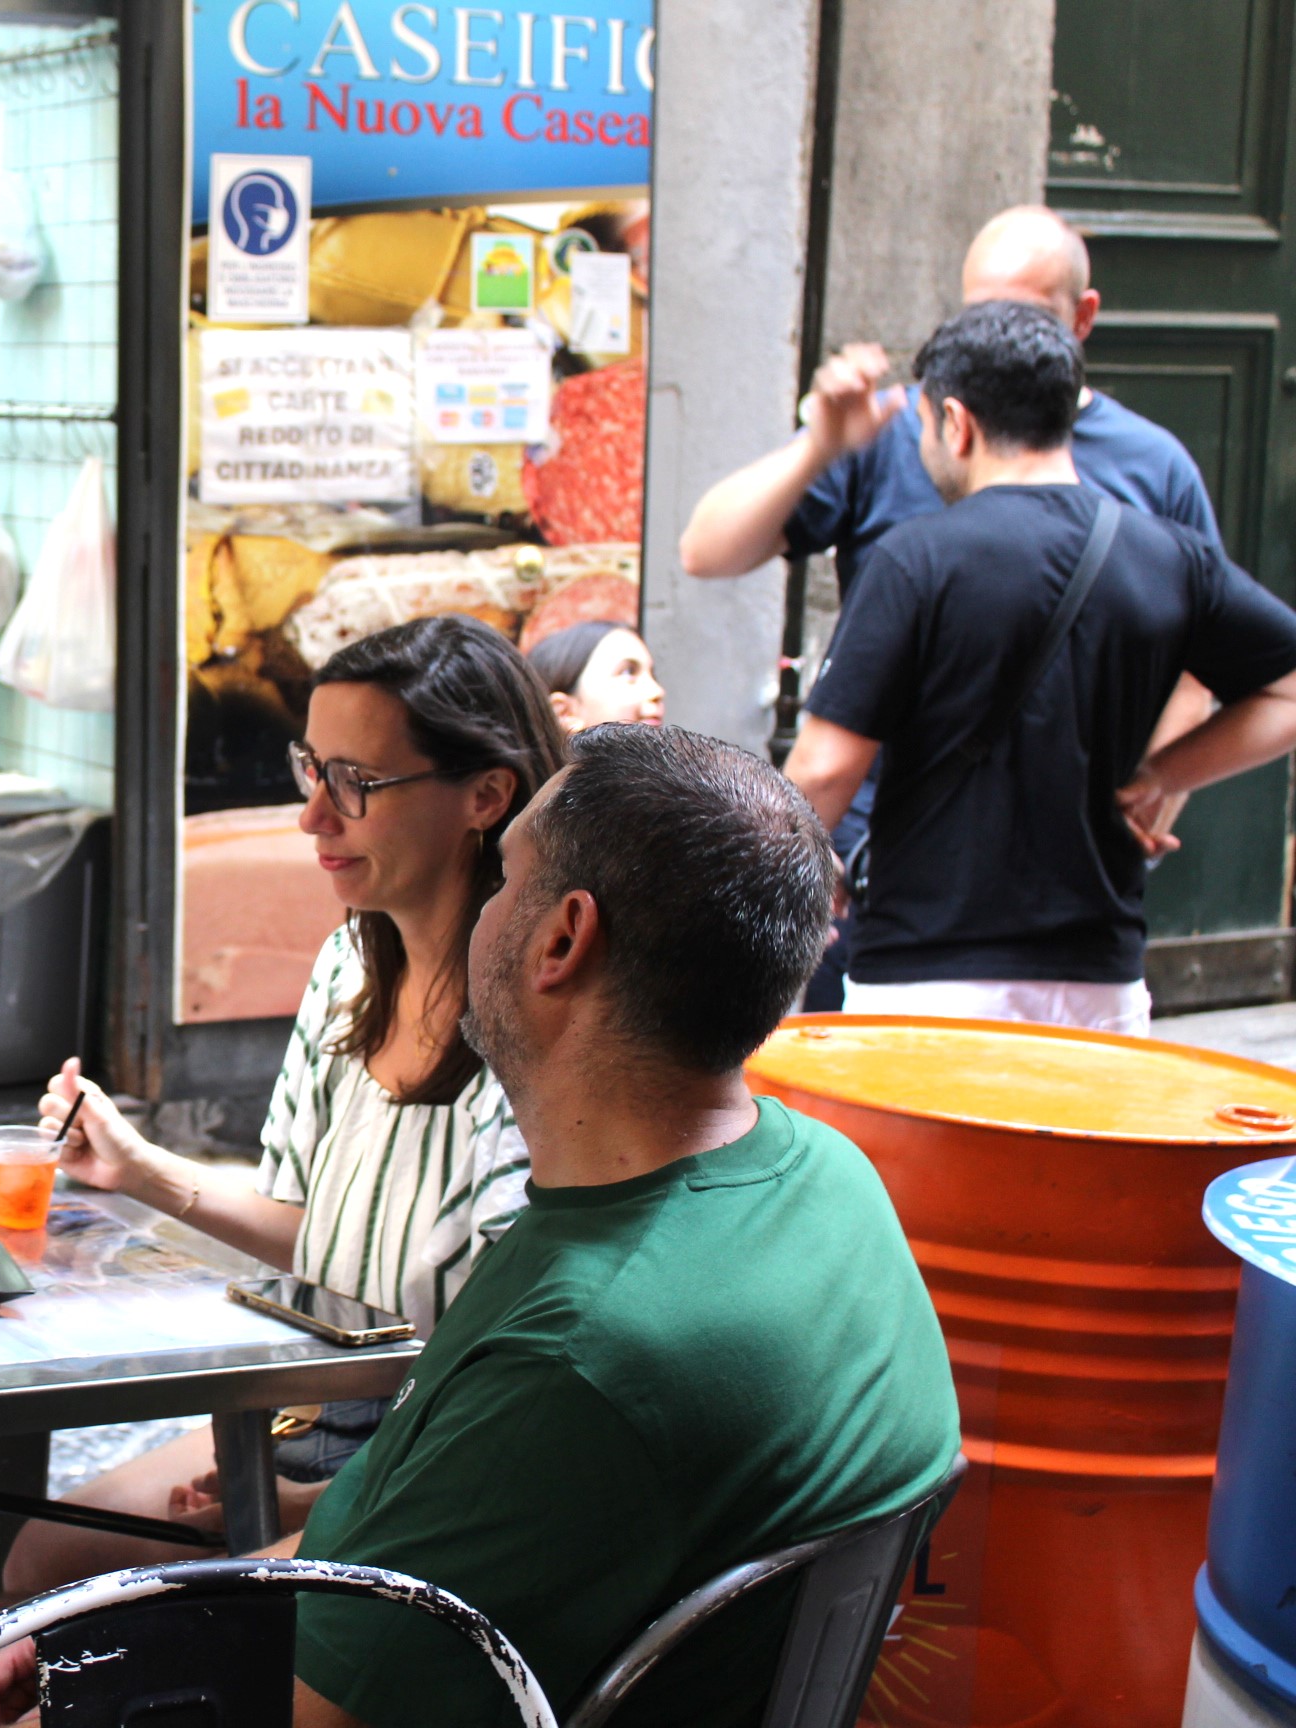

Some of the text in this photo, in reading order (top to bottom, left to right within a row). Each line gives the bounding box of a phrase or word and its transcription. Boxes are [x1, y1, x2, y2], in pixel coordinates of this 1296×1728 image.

[235, 78, 651, 147] la Nuova Casea
[268, 390, 347, 412] CARTE
